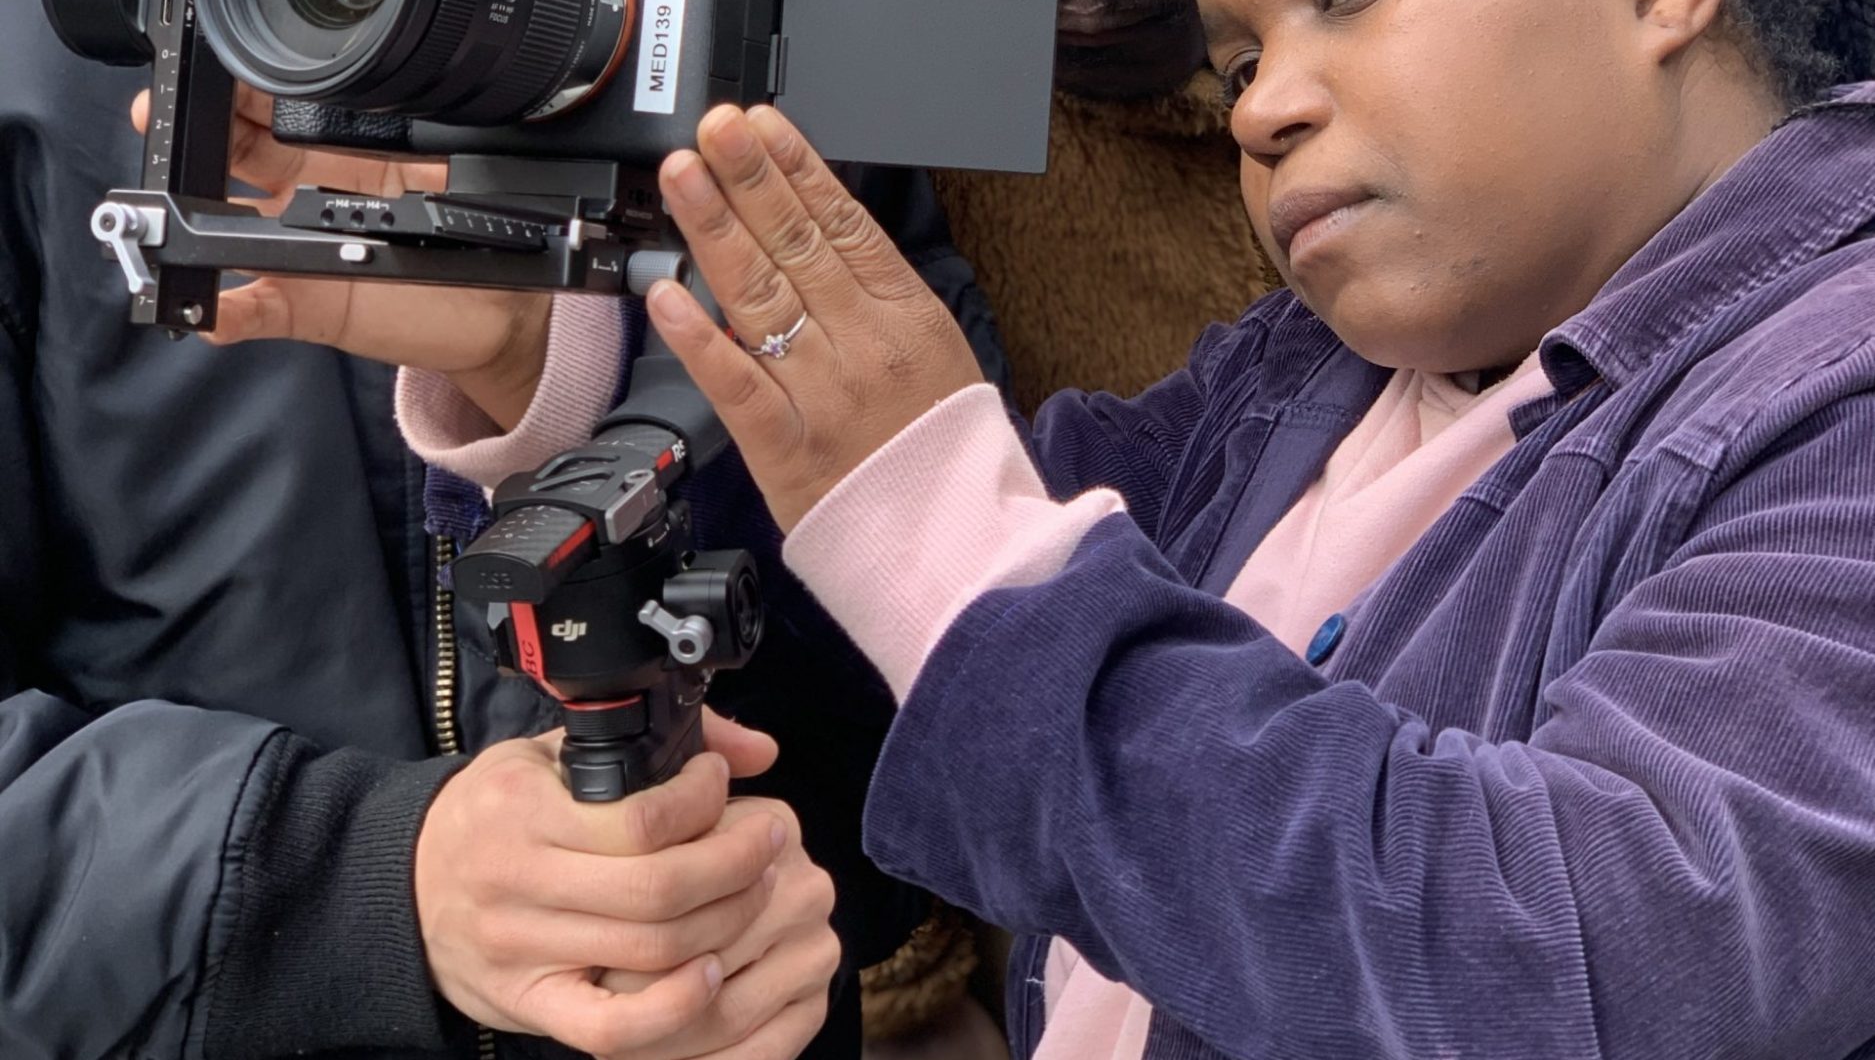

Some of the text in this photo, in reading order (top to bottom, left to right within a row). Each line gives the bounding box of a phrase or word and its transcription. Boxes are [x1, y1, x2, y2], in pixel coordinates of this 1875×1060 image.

[489, 12, 509, 24] FOCUS
[161, 49, 169, 59] 0
[649, 5, 671, 92] MED139
[156, 119, 162, 129] 2
[152, 154, 159, 165] 3
[140, 295, 146, 306] 7
